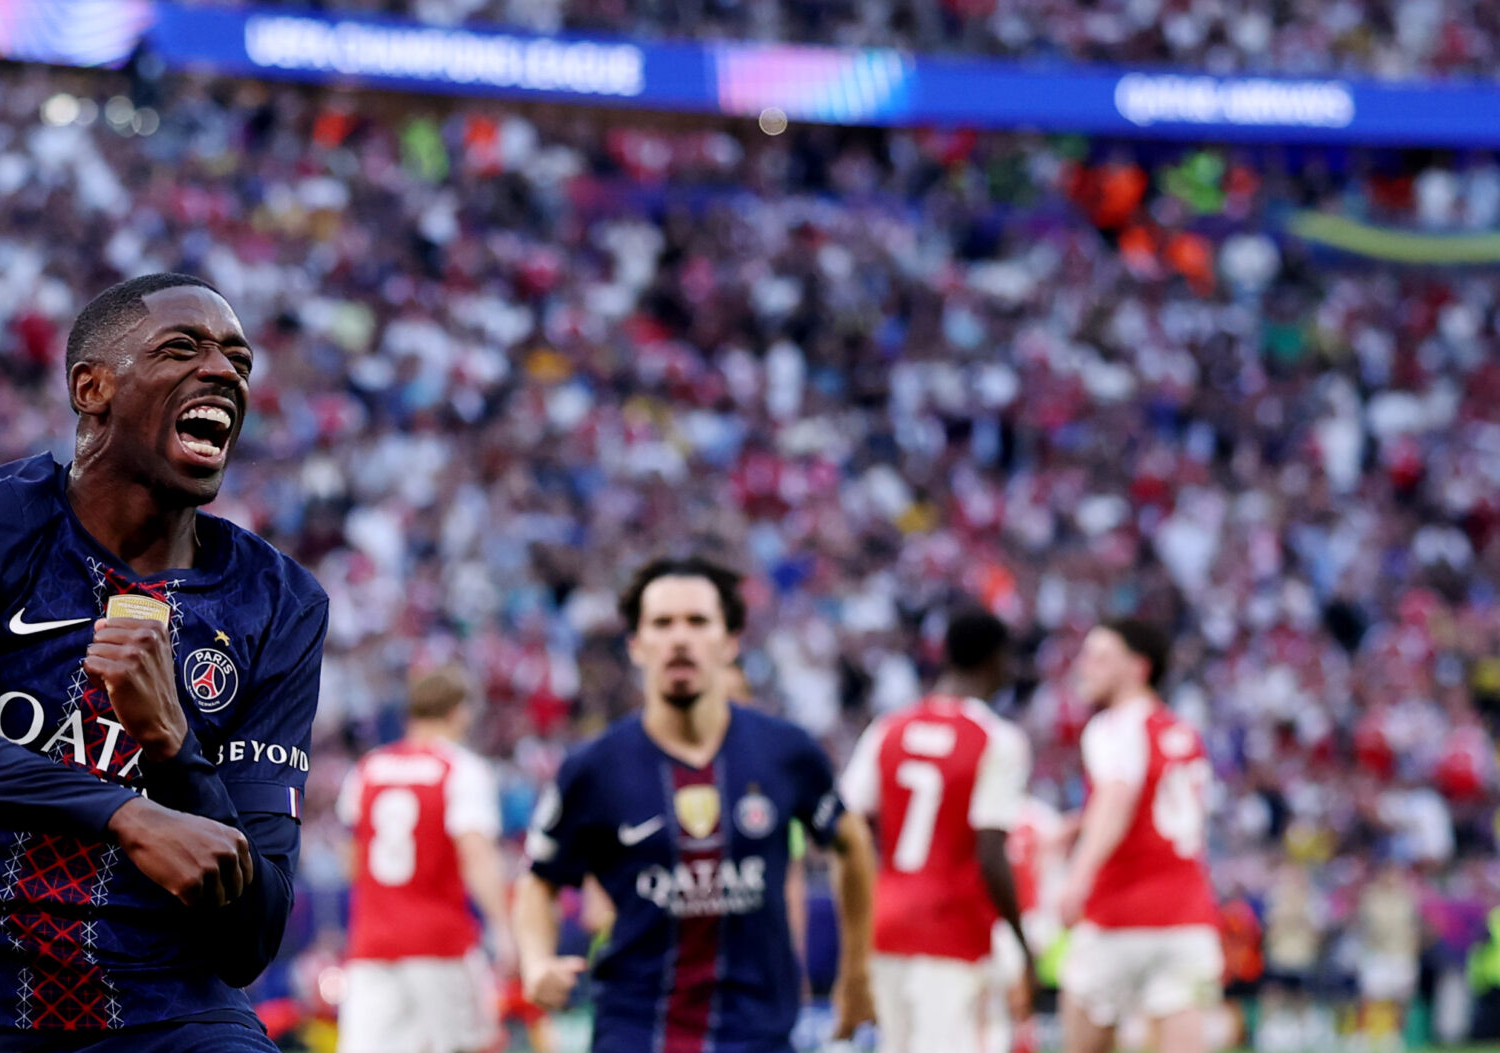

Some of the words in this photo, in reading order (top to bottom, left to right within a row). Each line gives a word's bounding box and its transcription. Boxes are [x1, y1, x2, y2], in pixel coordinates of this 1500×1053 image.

[194, 651, 234, 676] PARIS
[368, 787, 420, 887] 8
[893, 760, 944, 873] 7
[636, 856, 766, 908] QATAR
